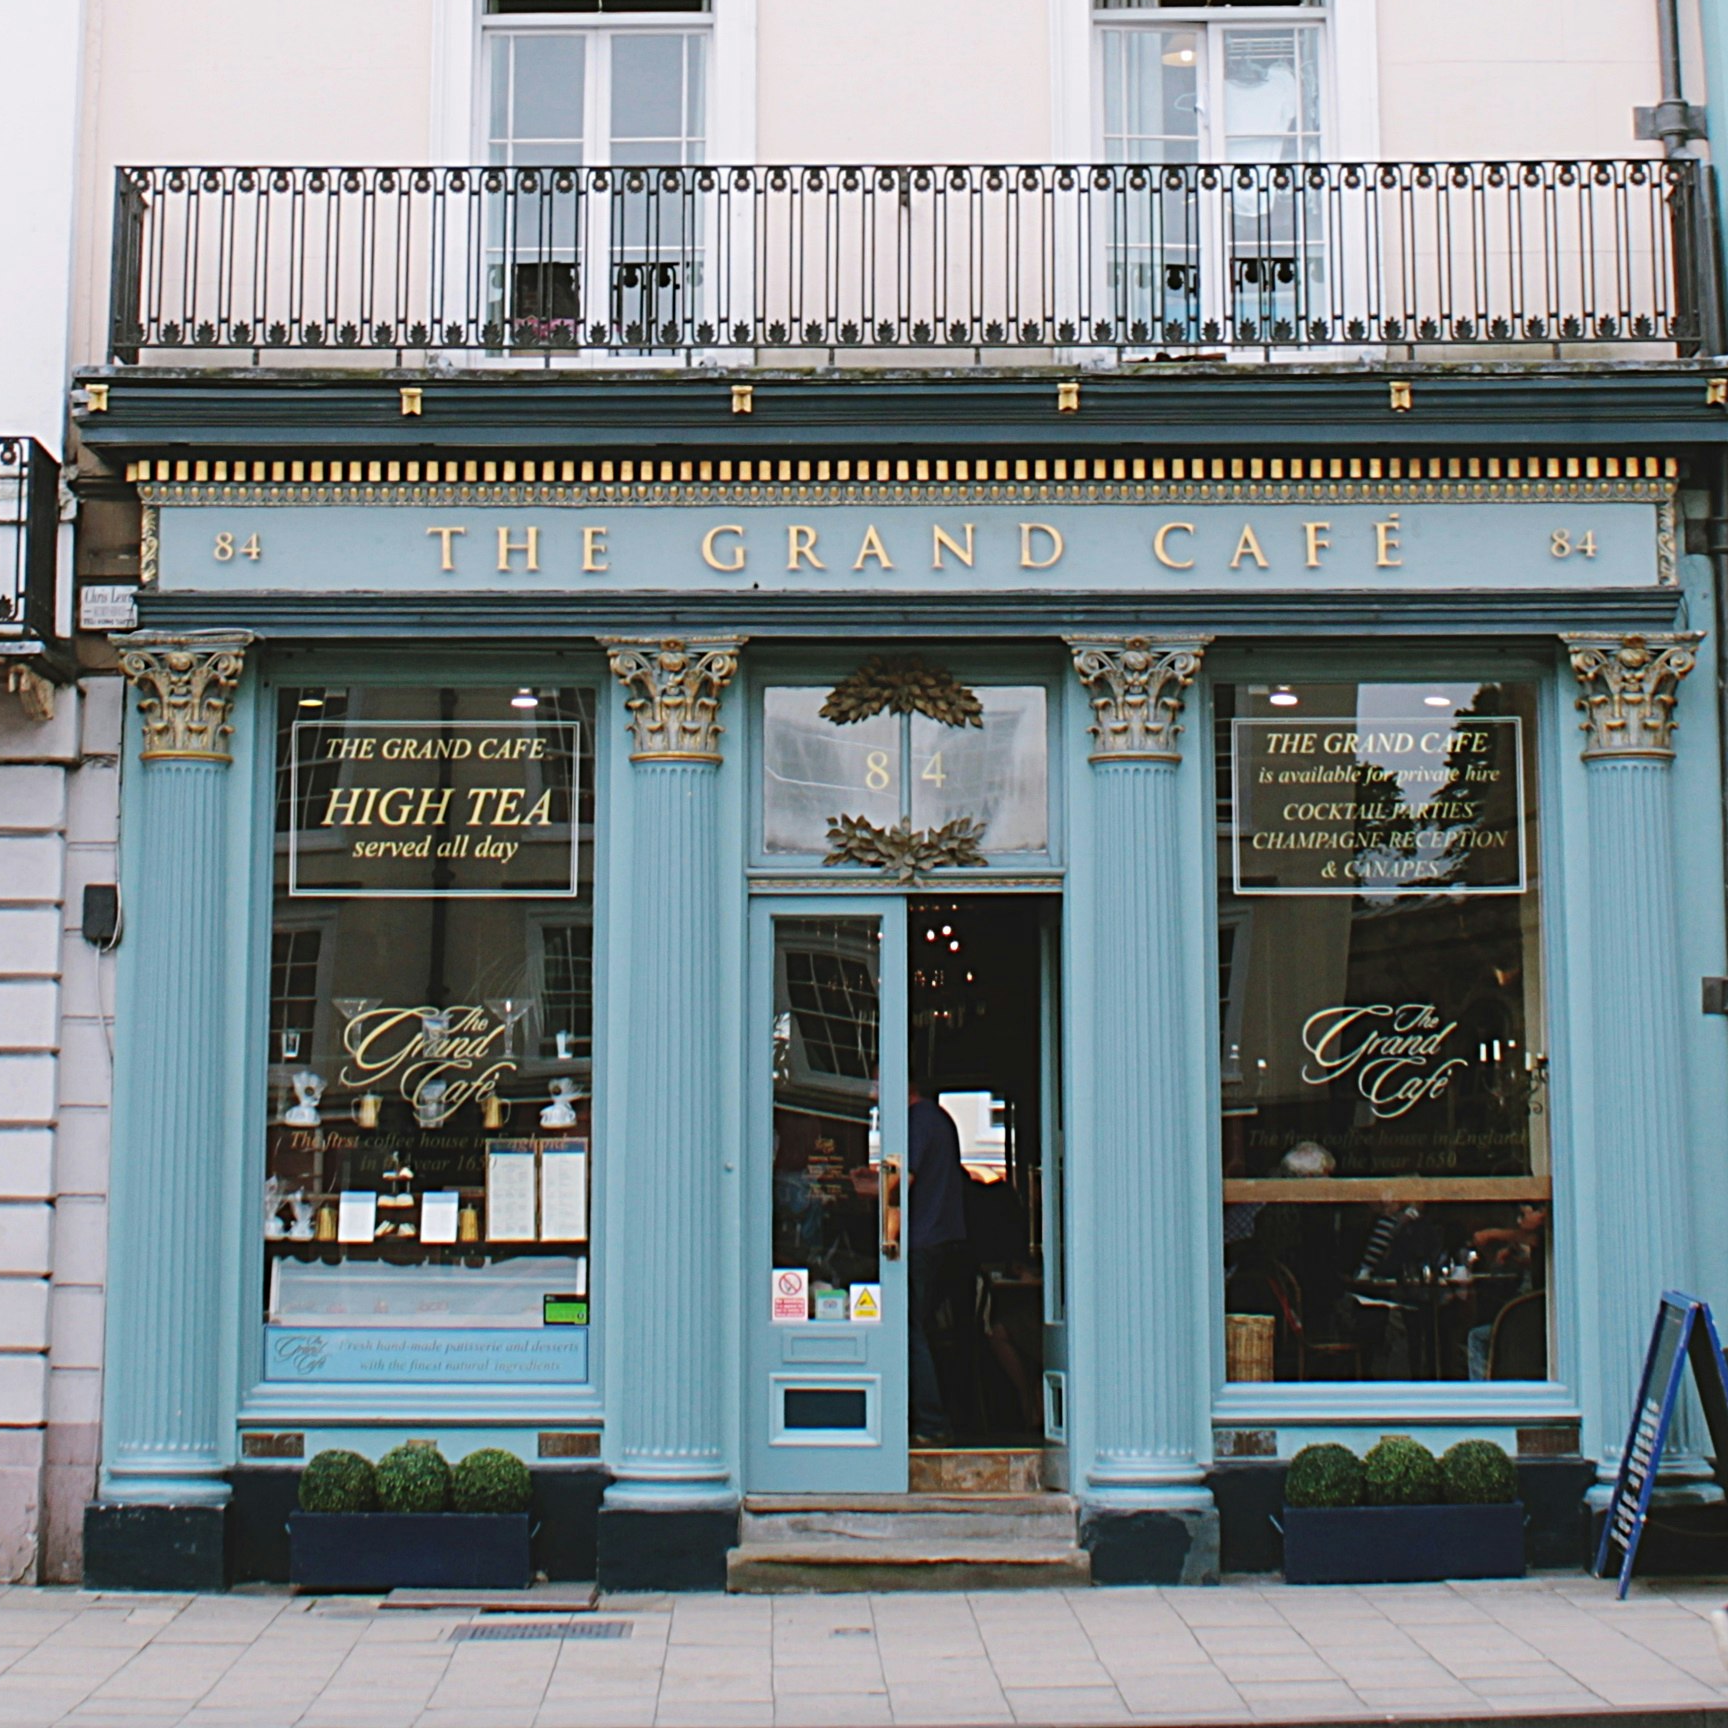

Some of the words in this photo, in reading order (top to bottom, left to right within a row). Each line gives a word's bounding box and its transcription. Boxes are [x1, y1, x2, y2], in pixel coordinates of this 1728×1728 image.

[213, 532, 262, 562] 84
[427, 525, 611, 572] THE
[701, 523, 1066, 572] GRAND
[1153, 514, 1403, 569] CAFÉ
[1550, 528, 1599, 559] 84
[326, 738, 376, 759] THE
[382, 738, 472, 759] GRAND
[478, 738, 547, 759] CAFE
[1266, 733, 1317, 754] THE
[1323, 732, 1414, 754] GRAND
[1420, 732, 1488, 753] CAFE
[1259, 767, 1272, 784] is
[1278, 765, 1361, 784] available
[1362, 765, 1390, 785] for
[1393, 767, 1459, 786] private
[1465, 765, 1500, 782] hire
[321, 787, 456, 826] HIGH
[466, 787, 552, 826] TEA
[1282, 802, 1388, 821] COCKTAIL
[1392, 802, 1474, 821] PARTIES
[352, 835, 432, 858] served
[437, 835, 467, 858] all
[474, 835, 518, 864] day
[1252, 831, 1384, 849] CHAMPAGNE
[1389, 830, 1508, 849] RECEPTION
[1320, 860, 1336, 878] &
[1344, 860, 1440, 878] CANAPES
[441, 1005, 489, 1034] The
[1393, 1004, 1440, 1032] The
[341, 1006, 506, 1087] Grand
[1302, 1005, 1458, 1085] Grand
[1358, 1056, 1468, 1119] Café
[363, 1132, 415, 1154] coffee
[420, 1132, 470, 1149] house
[1378, 1129, 1427, 1147] house
[1414, 1150, 1459, 1170] 1650
[505, 1340, 528, 1352] and
